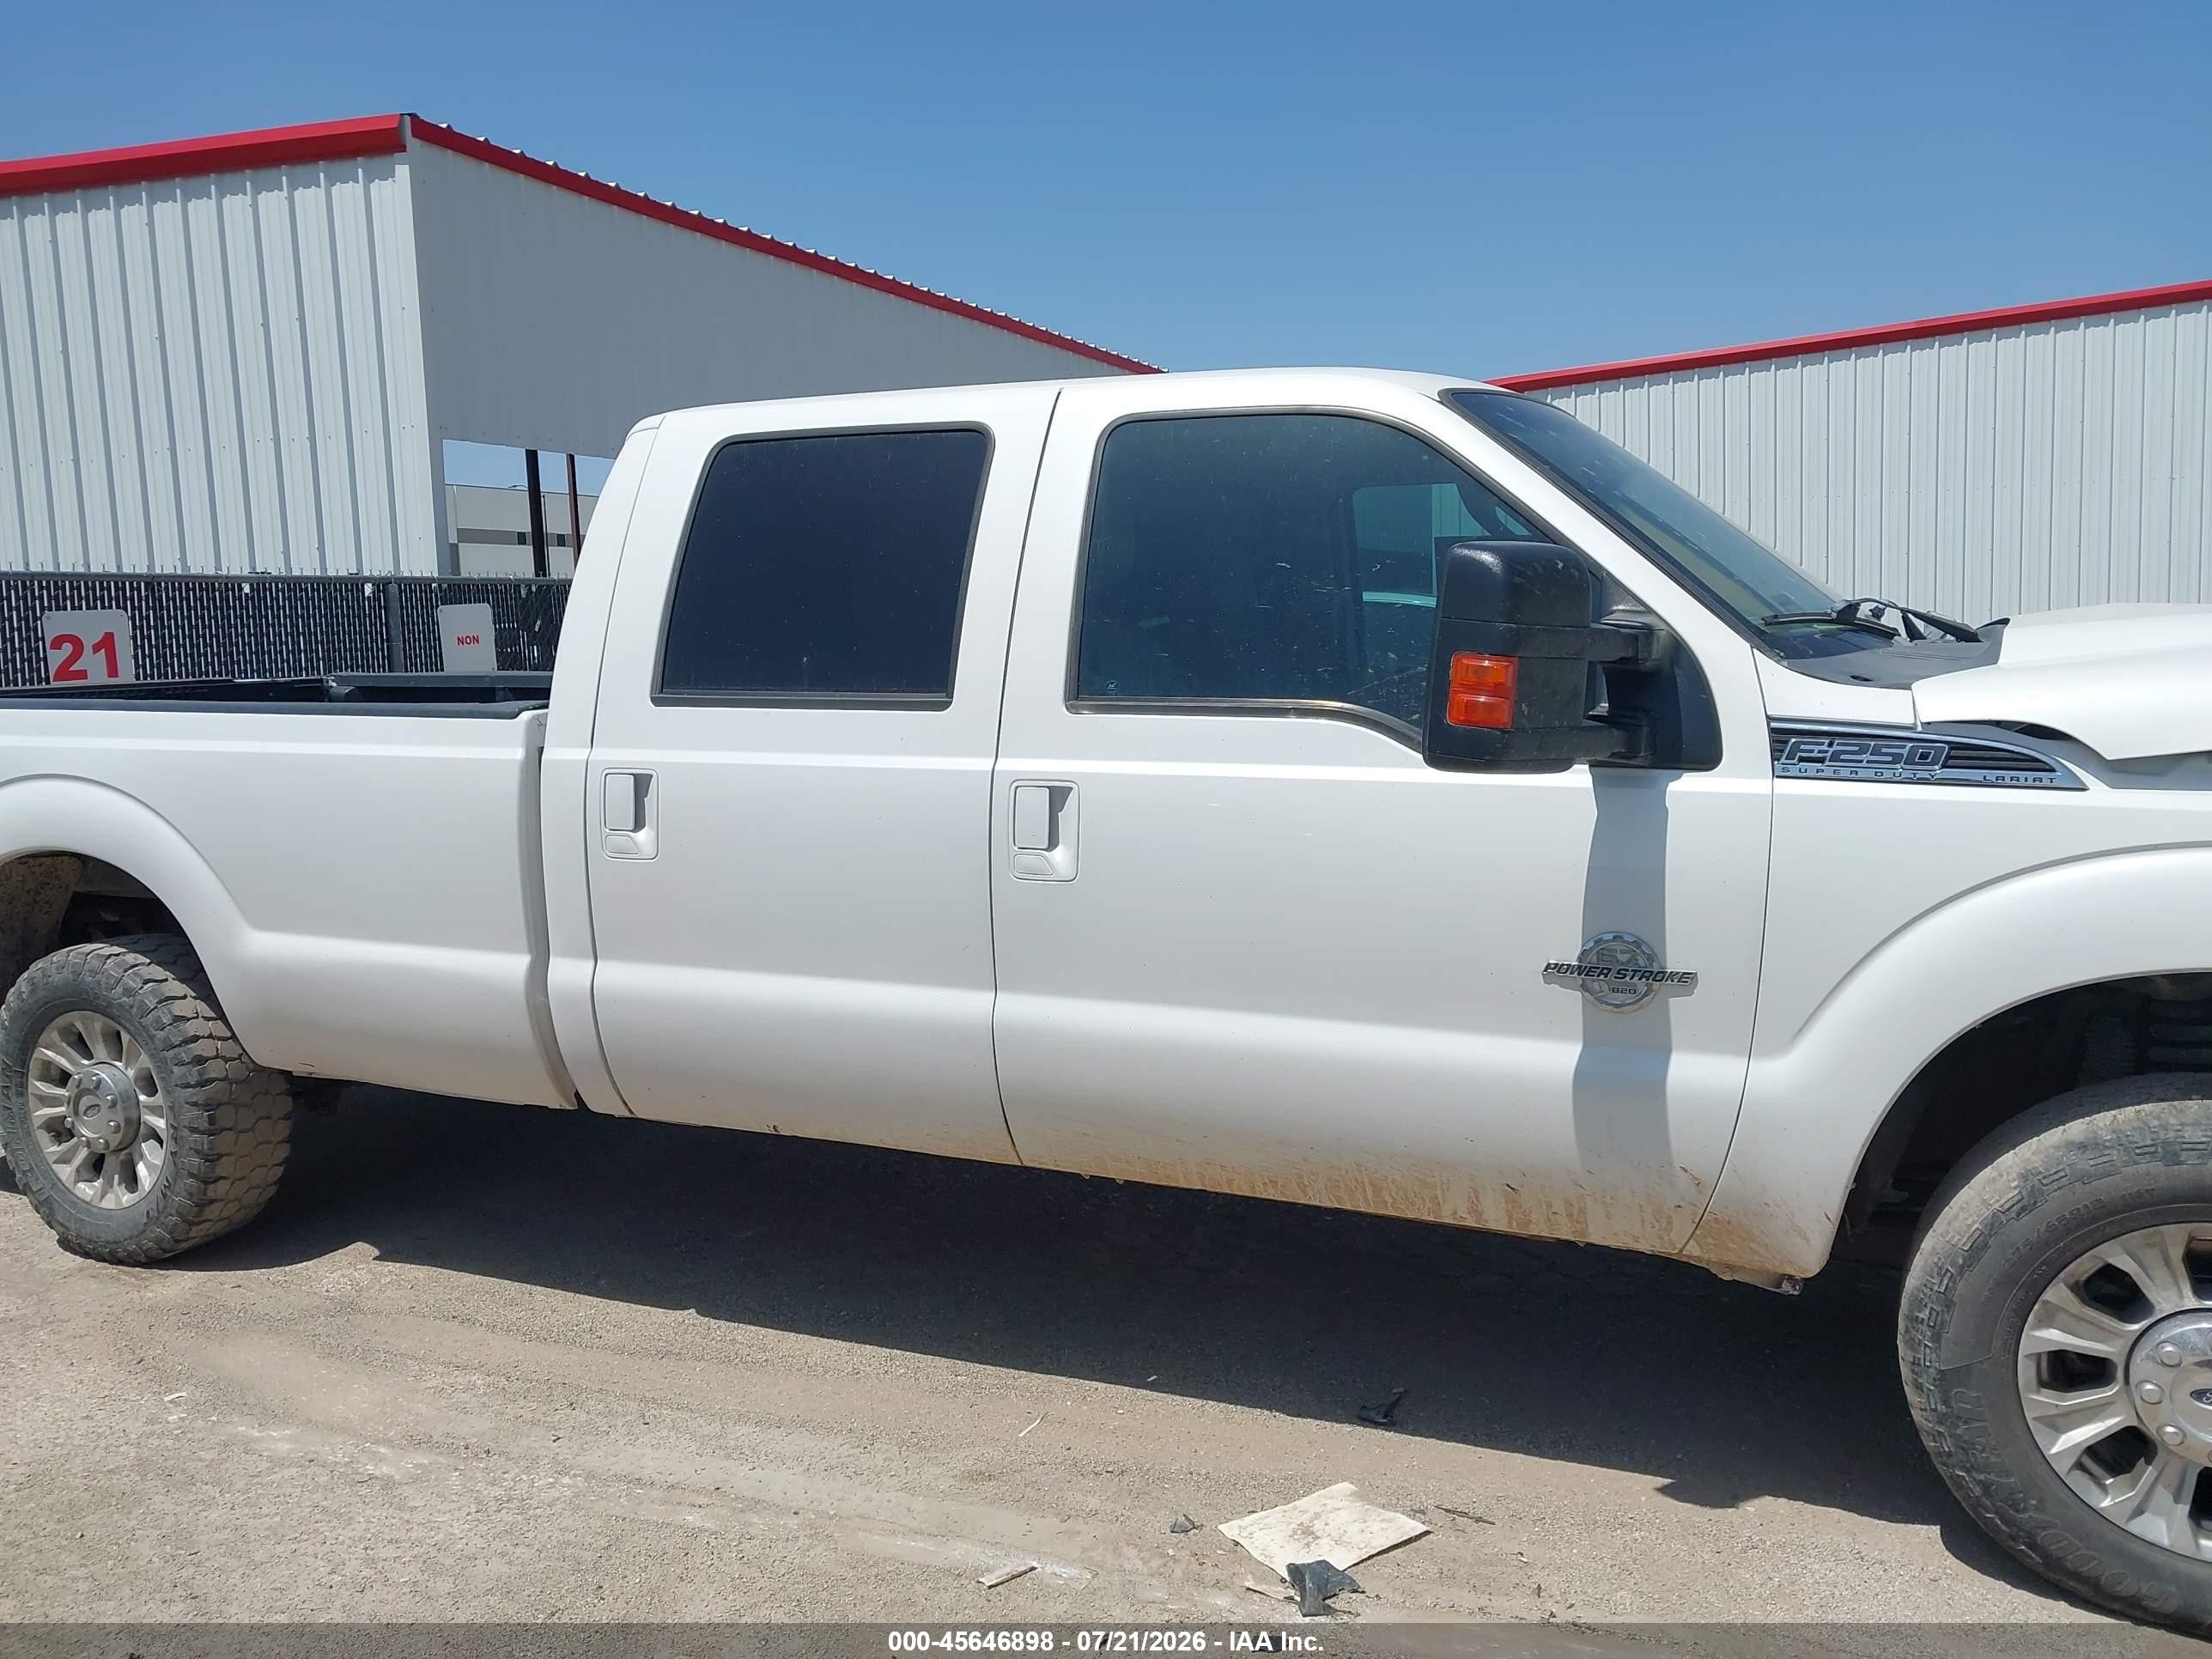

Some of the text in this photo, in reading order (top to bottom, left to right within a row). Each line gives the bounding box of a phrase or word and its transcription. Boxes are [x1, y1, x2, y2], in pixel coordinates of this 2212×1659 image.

[456, 634, 481, 647] NON
[49, 631, 120, 682] 21
[1780, 766, 1939, 781] SUPER DUTY
[1982, 775, 2059, 785] LARIAT
[1542, 962, 1698, 985] POWER STROKE
